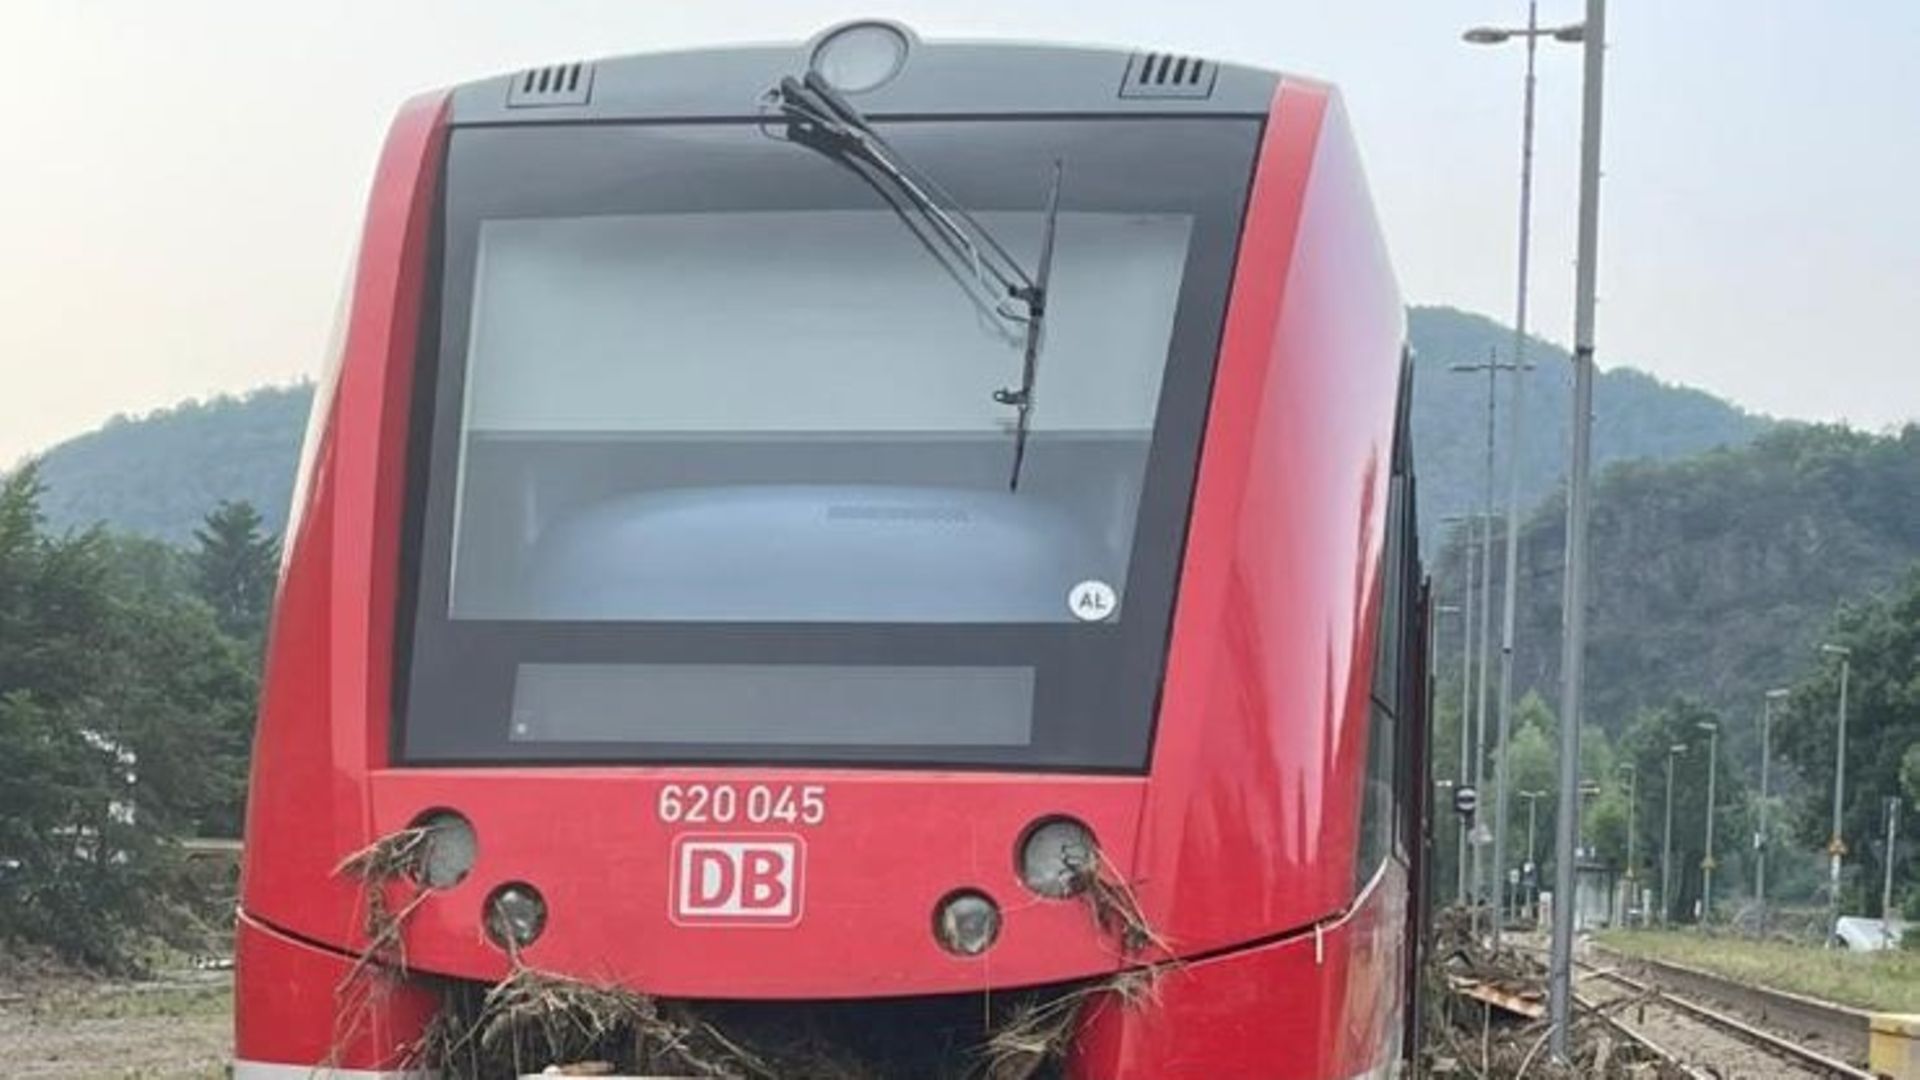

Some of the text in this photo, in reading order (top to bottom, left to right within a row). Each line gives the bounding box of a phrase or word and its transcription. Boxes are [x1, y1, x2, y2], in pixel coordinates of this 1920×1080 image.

[1079, 592, 1107, 610] AL
[659, 784, 826, 824] 620 045
[687, 848, 788, 910] DB
